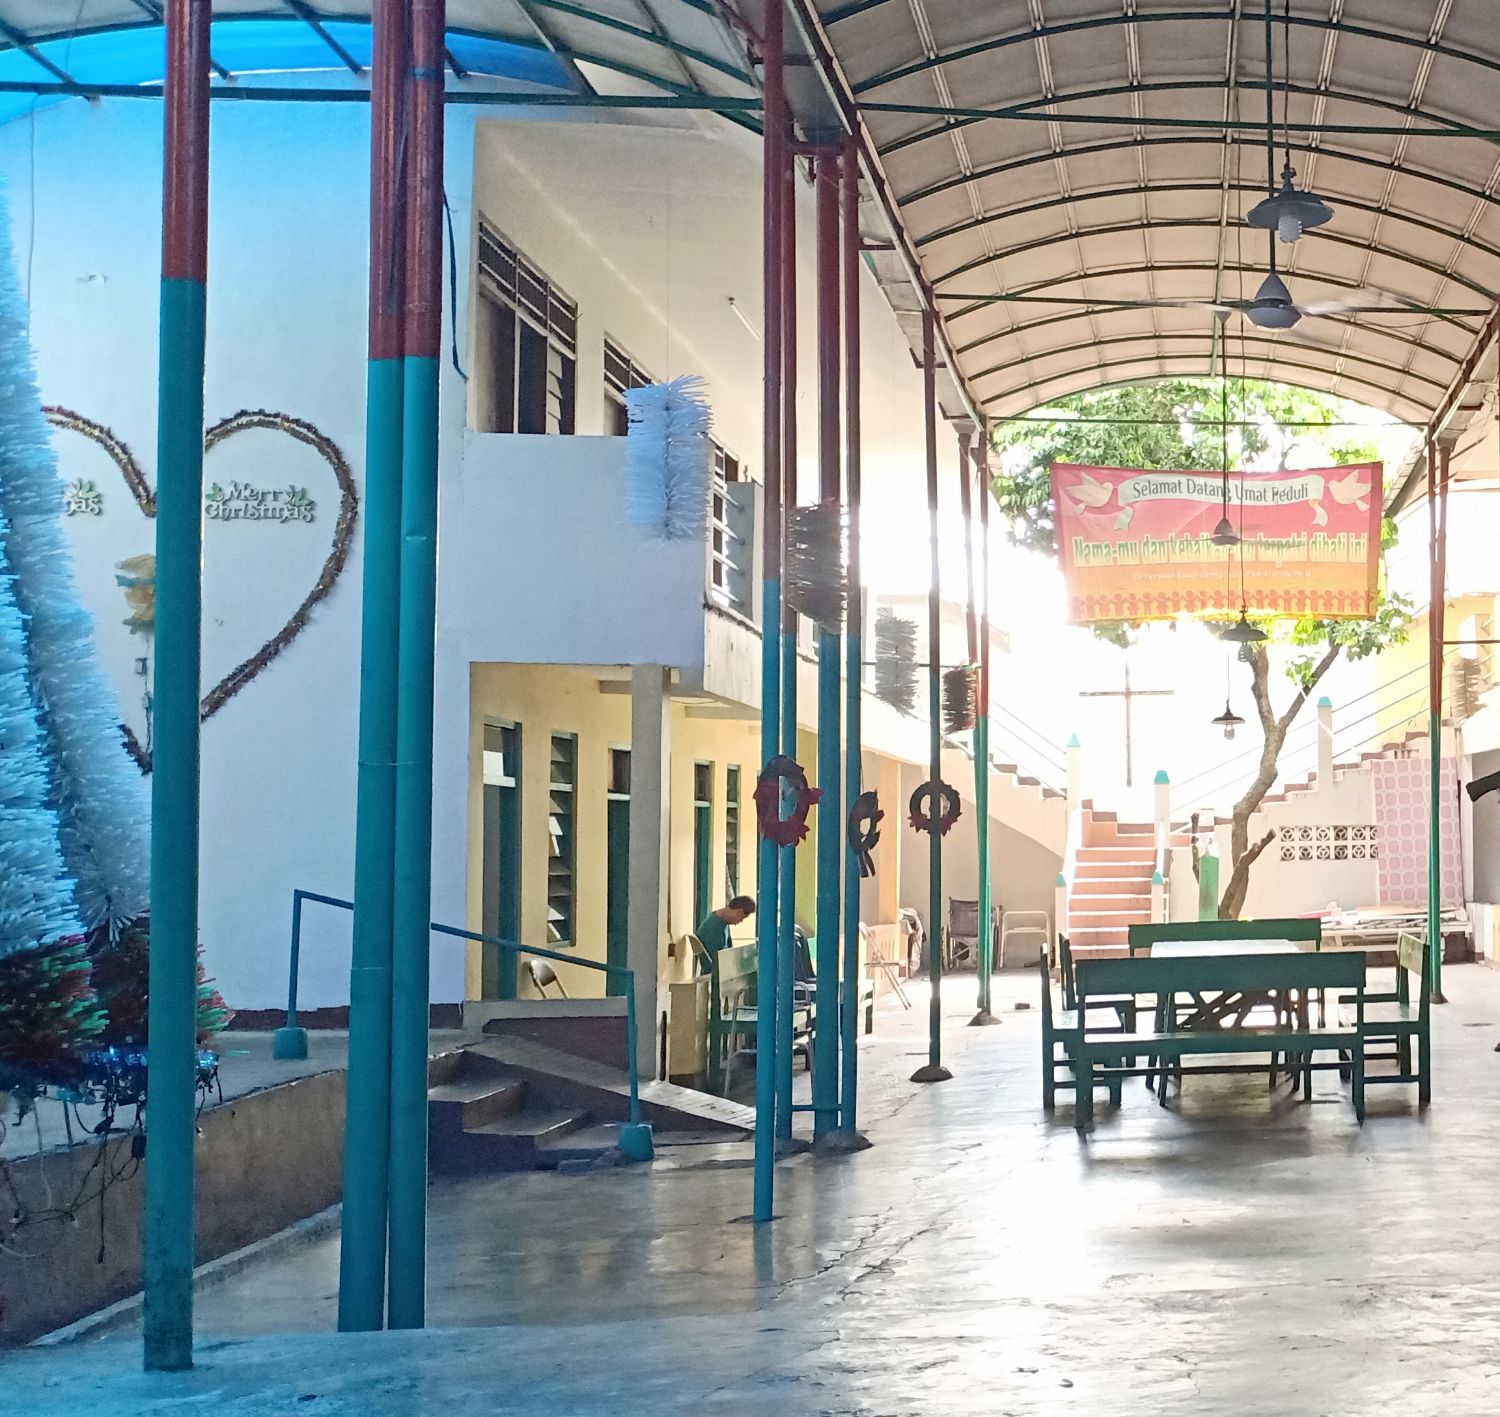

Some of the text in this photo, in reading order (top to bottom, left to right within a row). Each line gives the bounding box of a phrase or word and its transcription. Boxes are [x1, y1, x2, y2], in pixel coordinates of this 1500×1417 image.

[222, 480, 297, 507] Merry
[1132, 478, 1309, 503] Selamat Datang Umat Peduli
[205, 502, 315, 524] Christmas
[1073, 537, 1138, 566] Nama-mu
[1142, 534, 1166, 563] dan
[1310, 532, 1347, 562] dihati
[1349, 533, 1368, 562] ini
